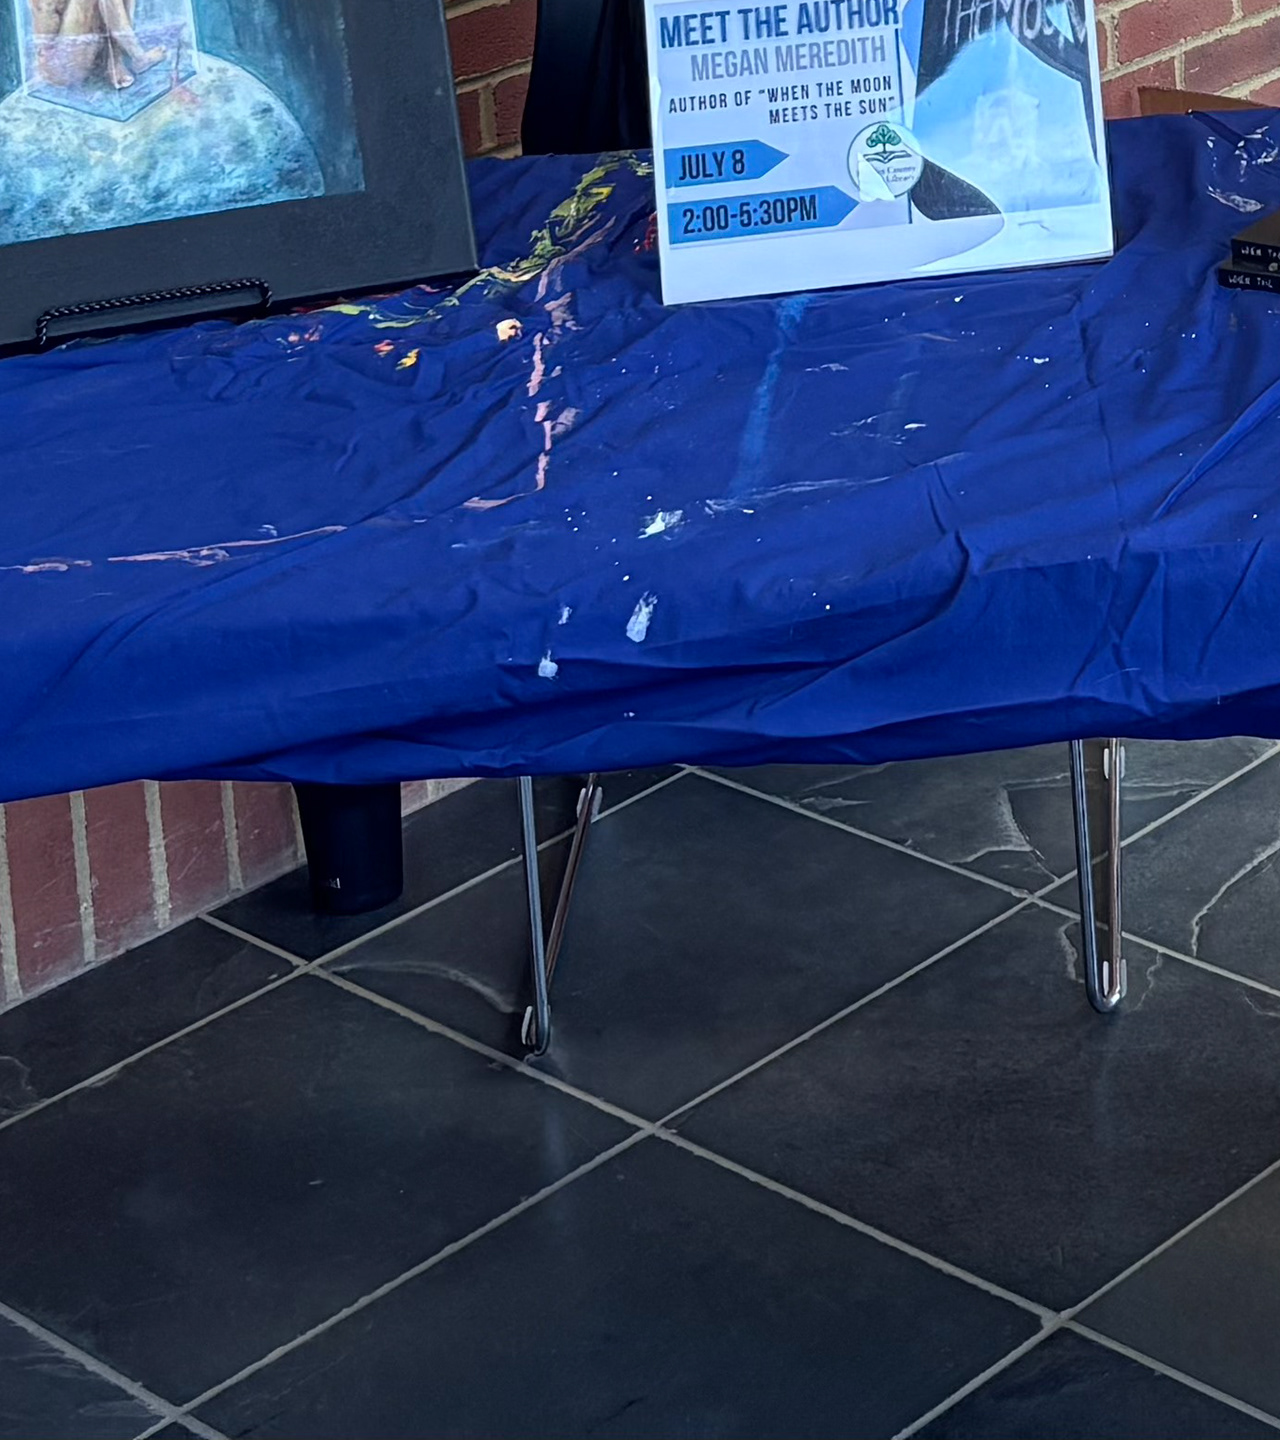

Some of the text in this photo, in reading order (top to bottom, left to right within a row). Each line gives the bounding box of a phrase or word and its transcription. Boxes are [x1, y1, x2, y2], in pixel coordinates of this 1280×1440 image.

[660, 10, 730, 49] MEET
[738, 6, 787, 40] THE
[691, 37, 886, 81] MEGAN MEREDITH
[669, 75, 892, 114] AUTHOR OF "WHEN THE MOON
[769, 105, 818, 124] MEETS
[824, 102, 852, 119] THE
[679, 150, 745, 181] JULY 8
[683, 195, 818, 234] 2:00-5:30PM
